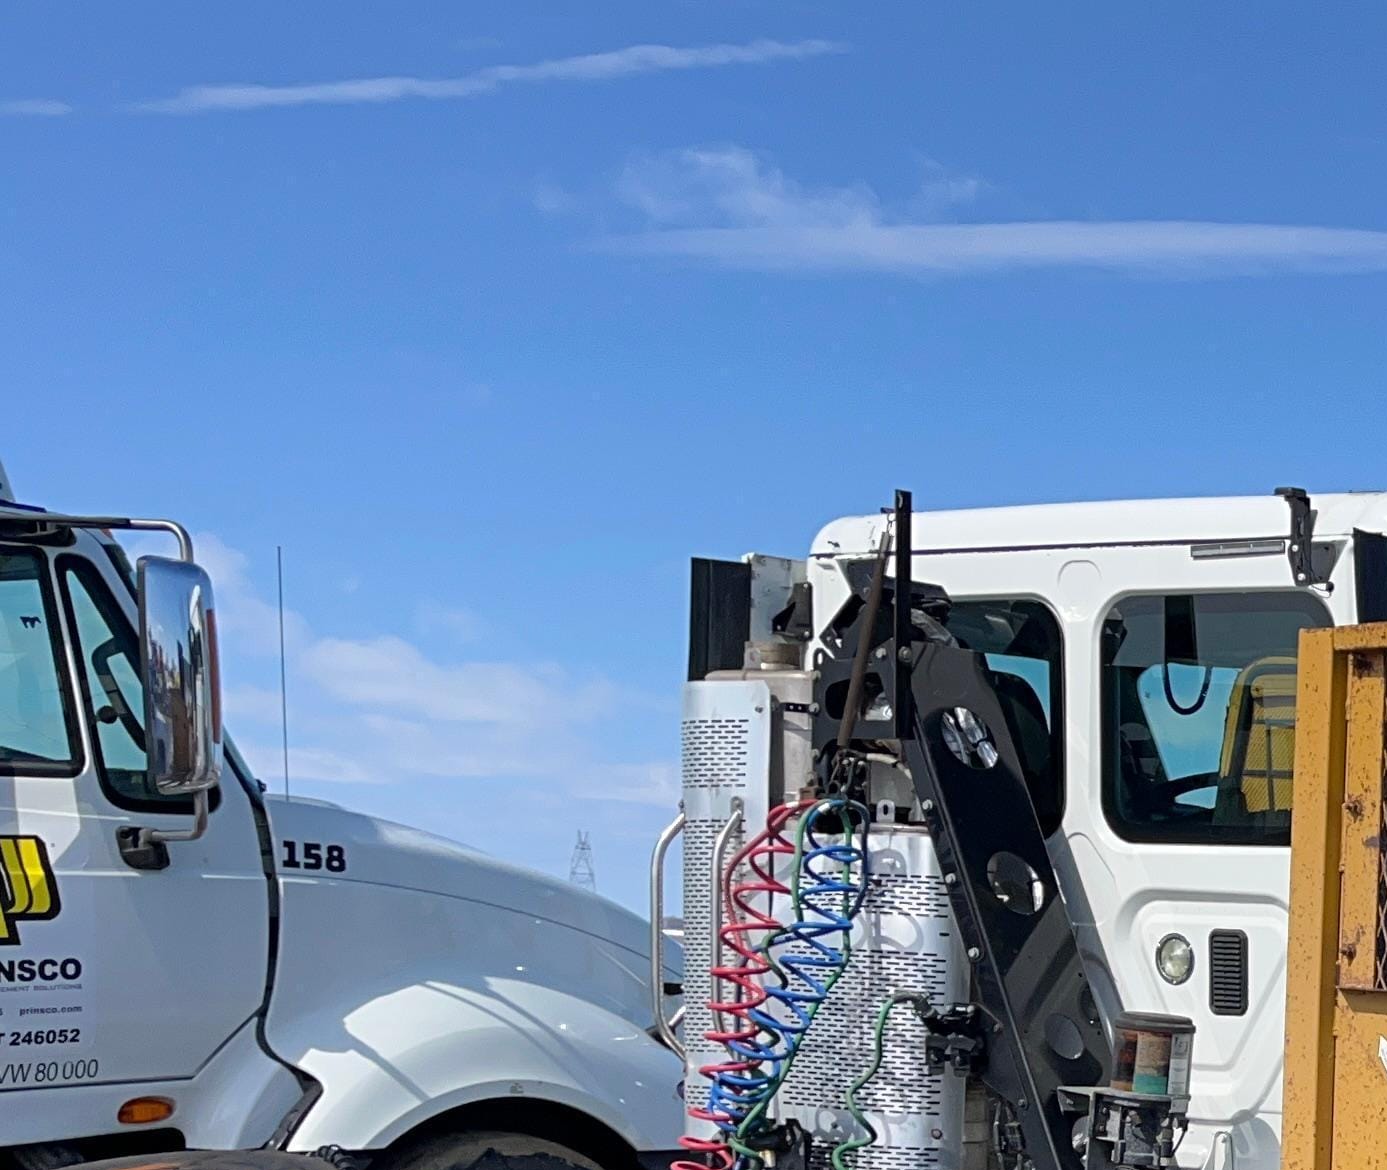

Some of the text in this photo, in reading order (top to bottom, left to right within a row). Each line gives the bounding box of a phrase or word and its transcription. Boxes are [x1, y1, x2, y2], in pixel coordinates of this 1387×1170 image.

[282, 840, 346, 872] 158
[19, 1005, 83, 1016] prinsco.com
[9, 1028, 80, 1046] 246052
